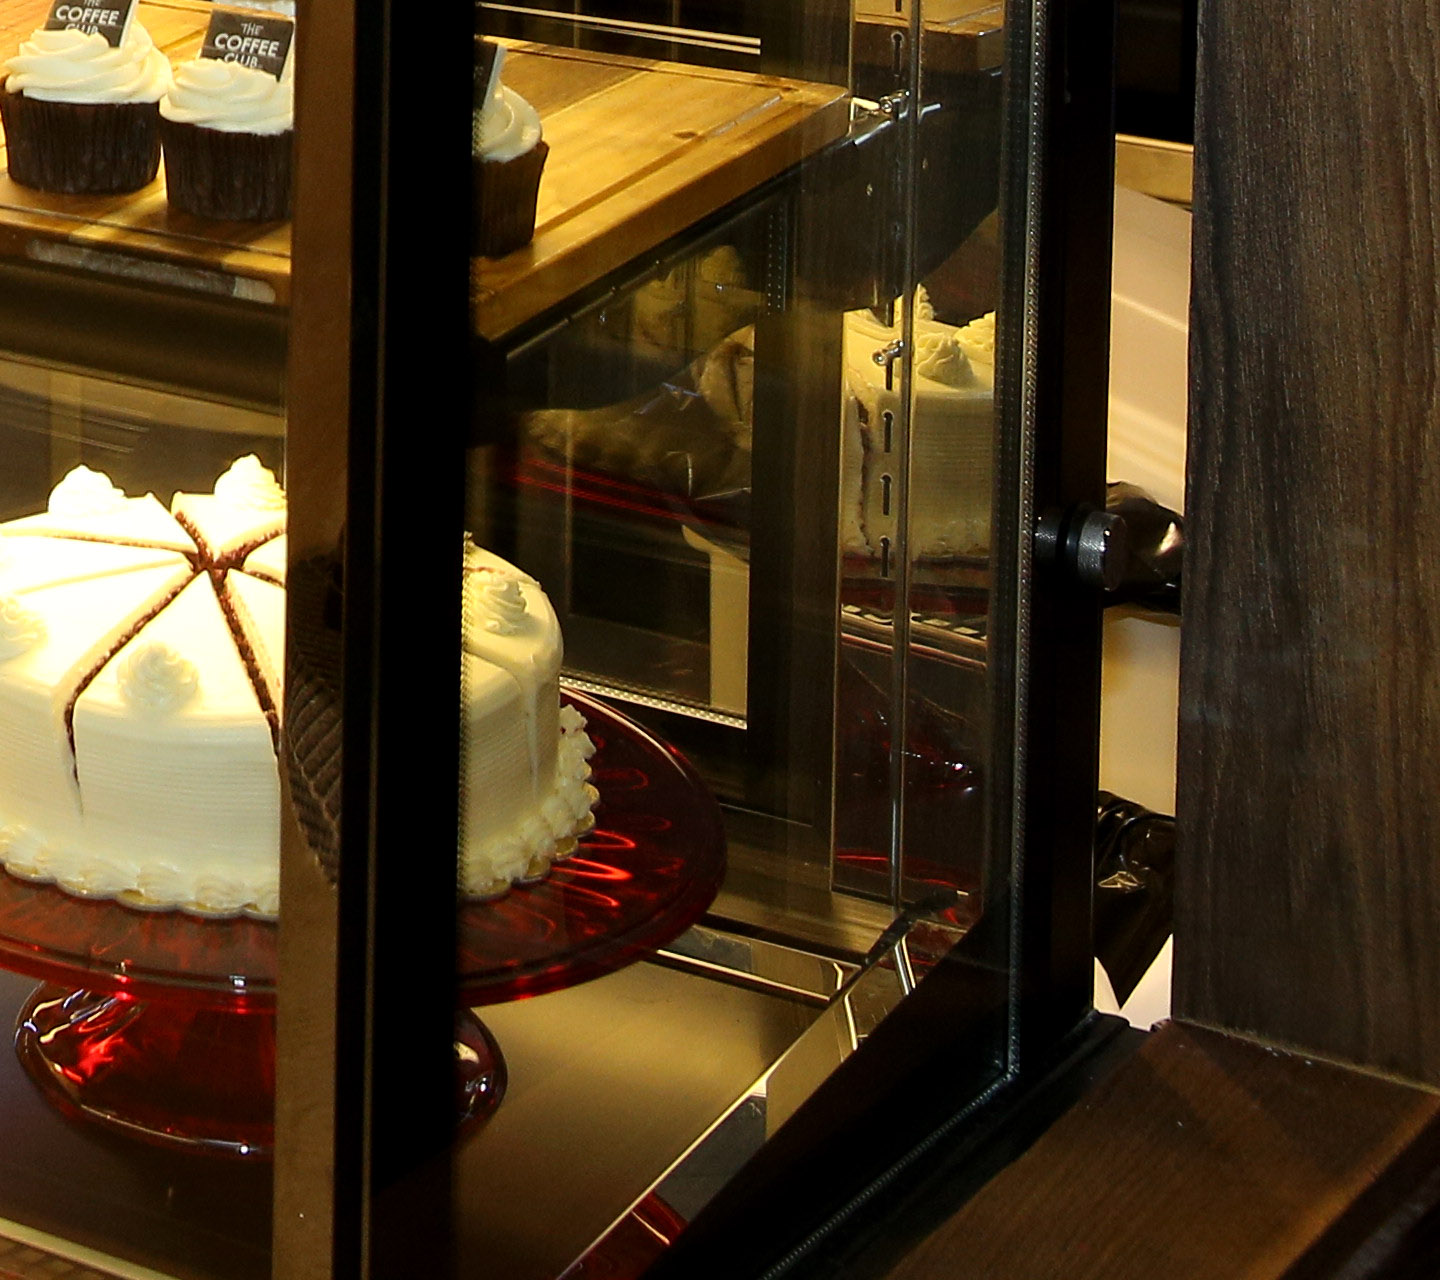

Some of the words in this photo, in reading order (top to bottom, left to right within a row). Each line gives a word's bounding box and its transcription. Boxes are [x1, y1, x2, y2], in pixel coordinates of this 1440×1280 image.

[55, 5, 120, 26] COFFEE
[241, 22, 264, 36] THE
[214, 32, 280, 58] COFFEE
